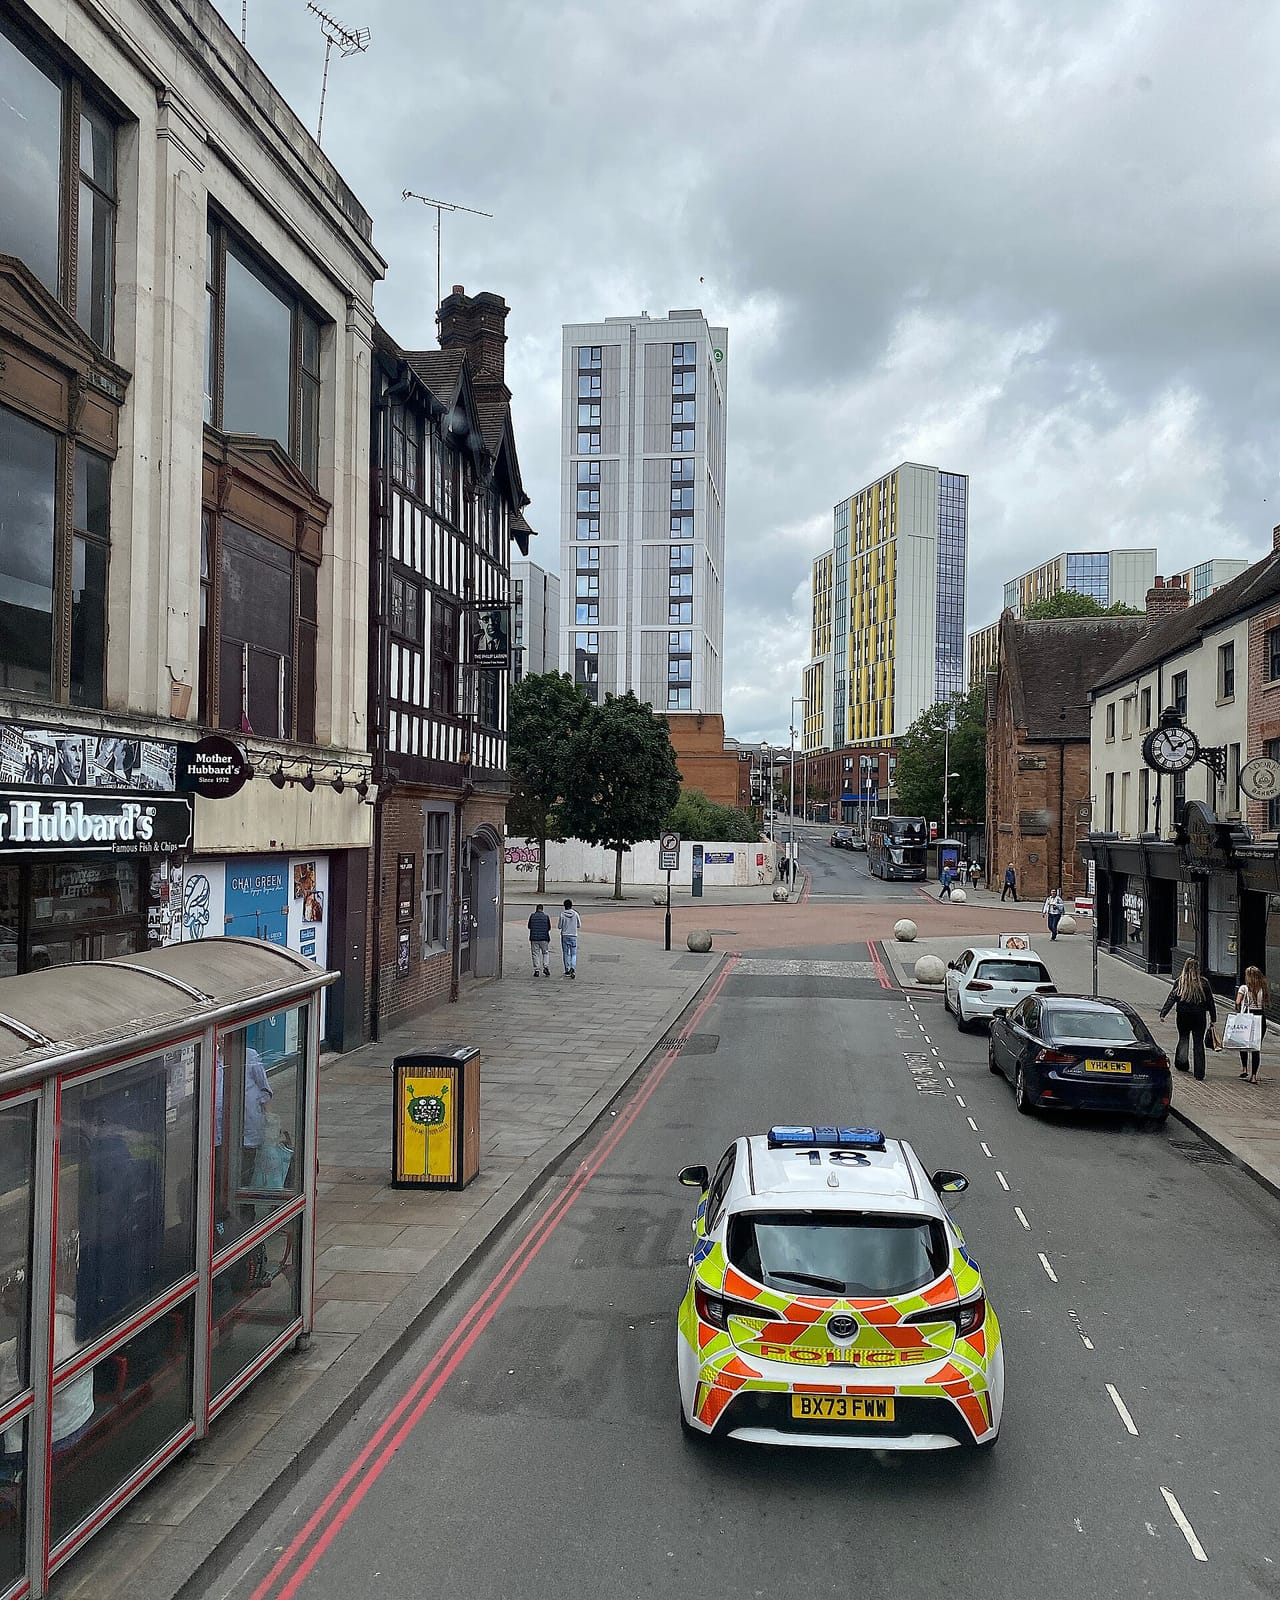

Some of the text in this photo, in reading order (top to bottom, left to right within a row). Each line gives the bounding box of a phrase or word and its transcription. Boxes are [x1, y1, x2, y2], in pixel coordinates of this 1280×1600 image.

[195, 753, 232, 763] Mother
[187, 764, 240, 775] Hubbard's
[9, 801, 153, 842] Hubbard's
[112, 842, 178, 853] Famous Fish & Chips
[232, 874, 282, 890] CHAI GREEN
[1091, 1061, 1127, 1071] YH14 EWS
[795, 1150, 872, 1167] 18
[760, 1345, 925, 1363] POLICE
[800, 1397, 887, 1417] BX73 FWW
